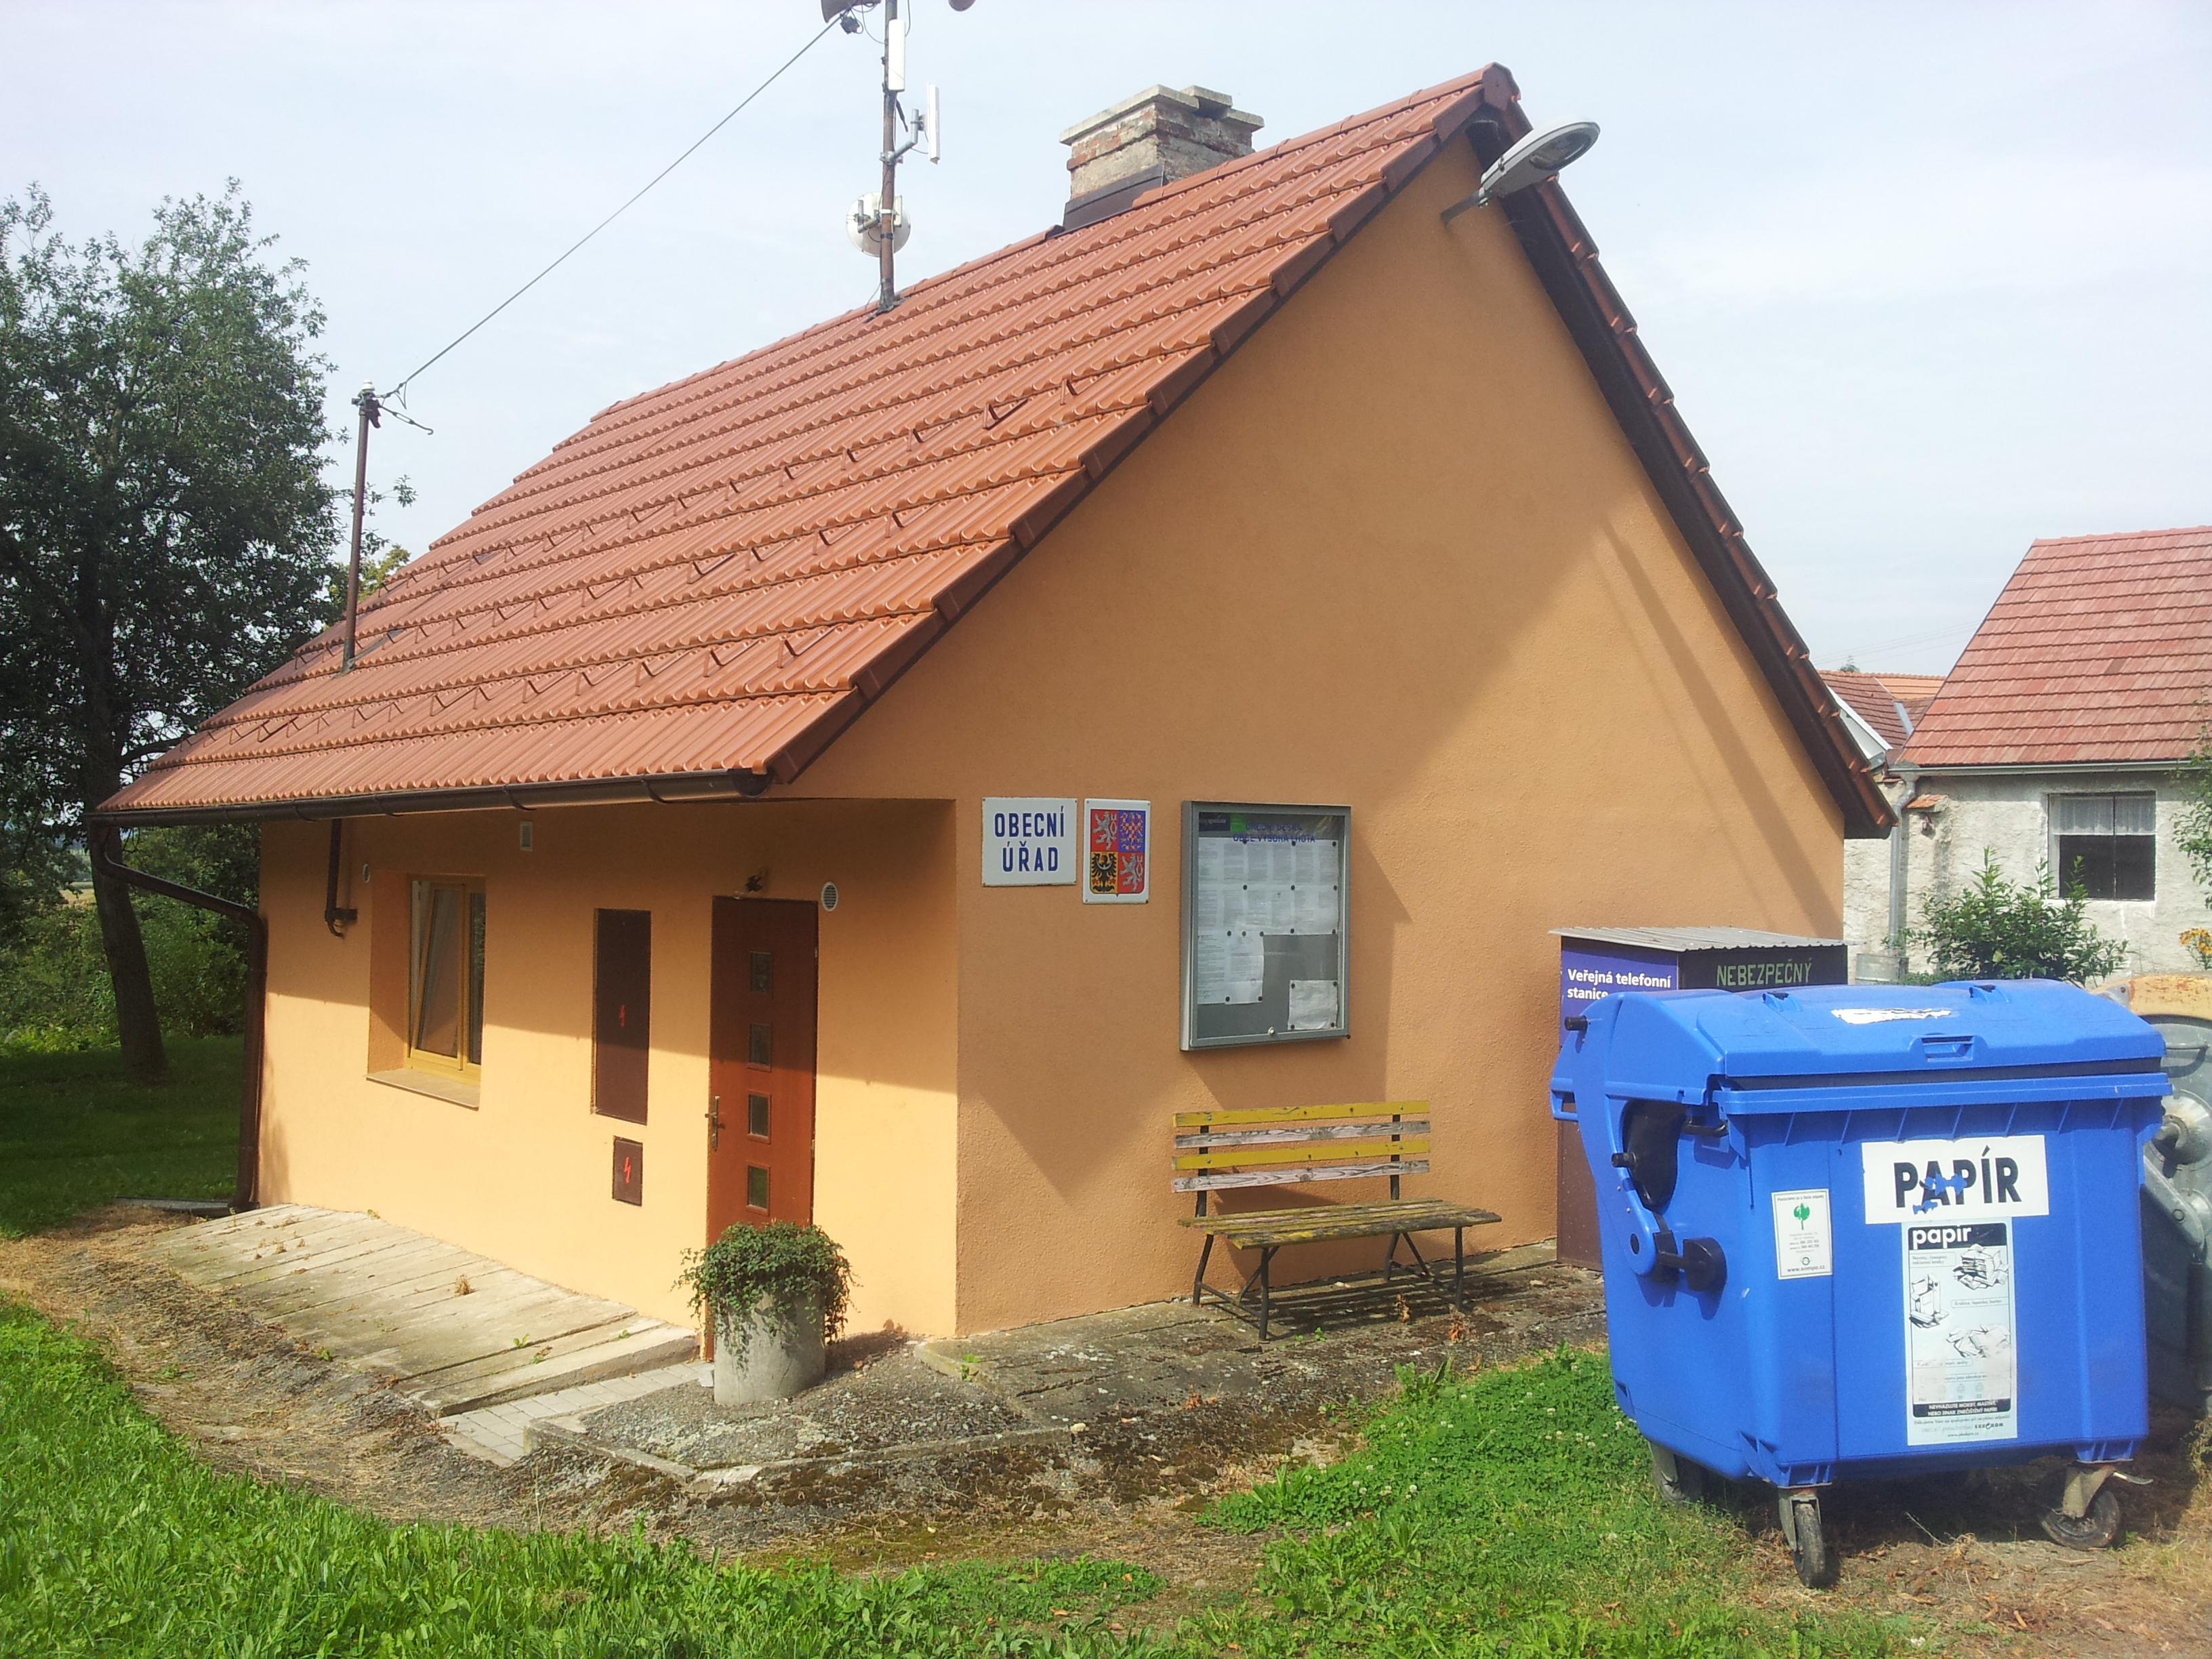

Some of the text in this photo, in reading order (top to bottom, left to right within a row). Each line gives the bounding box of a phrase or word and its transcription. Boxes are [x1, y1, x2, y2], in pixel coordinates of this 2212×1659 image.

[994, 806, 1065, 838] OBECNÍ
[1002, 841, 1059, 872] ÚŘAD
[1567, 968, 1671, 988] Veřejná telefonní
[1717, 957, 1811, 987] NEBEZPEČNÝ
[1567, 987, 1608, 1000] stanice
[1893, 1145, 2022, 1208] PAPÍR
